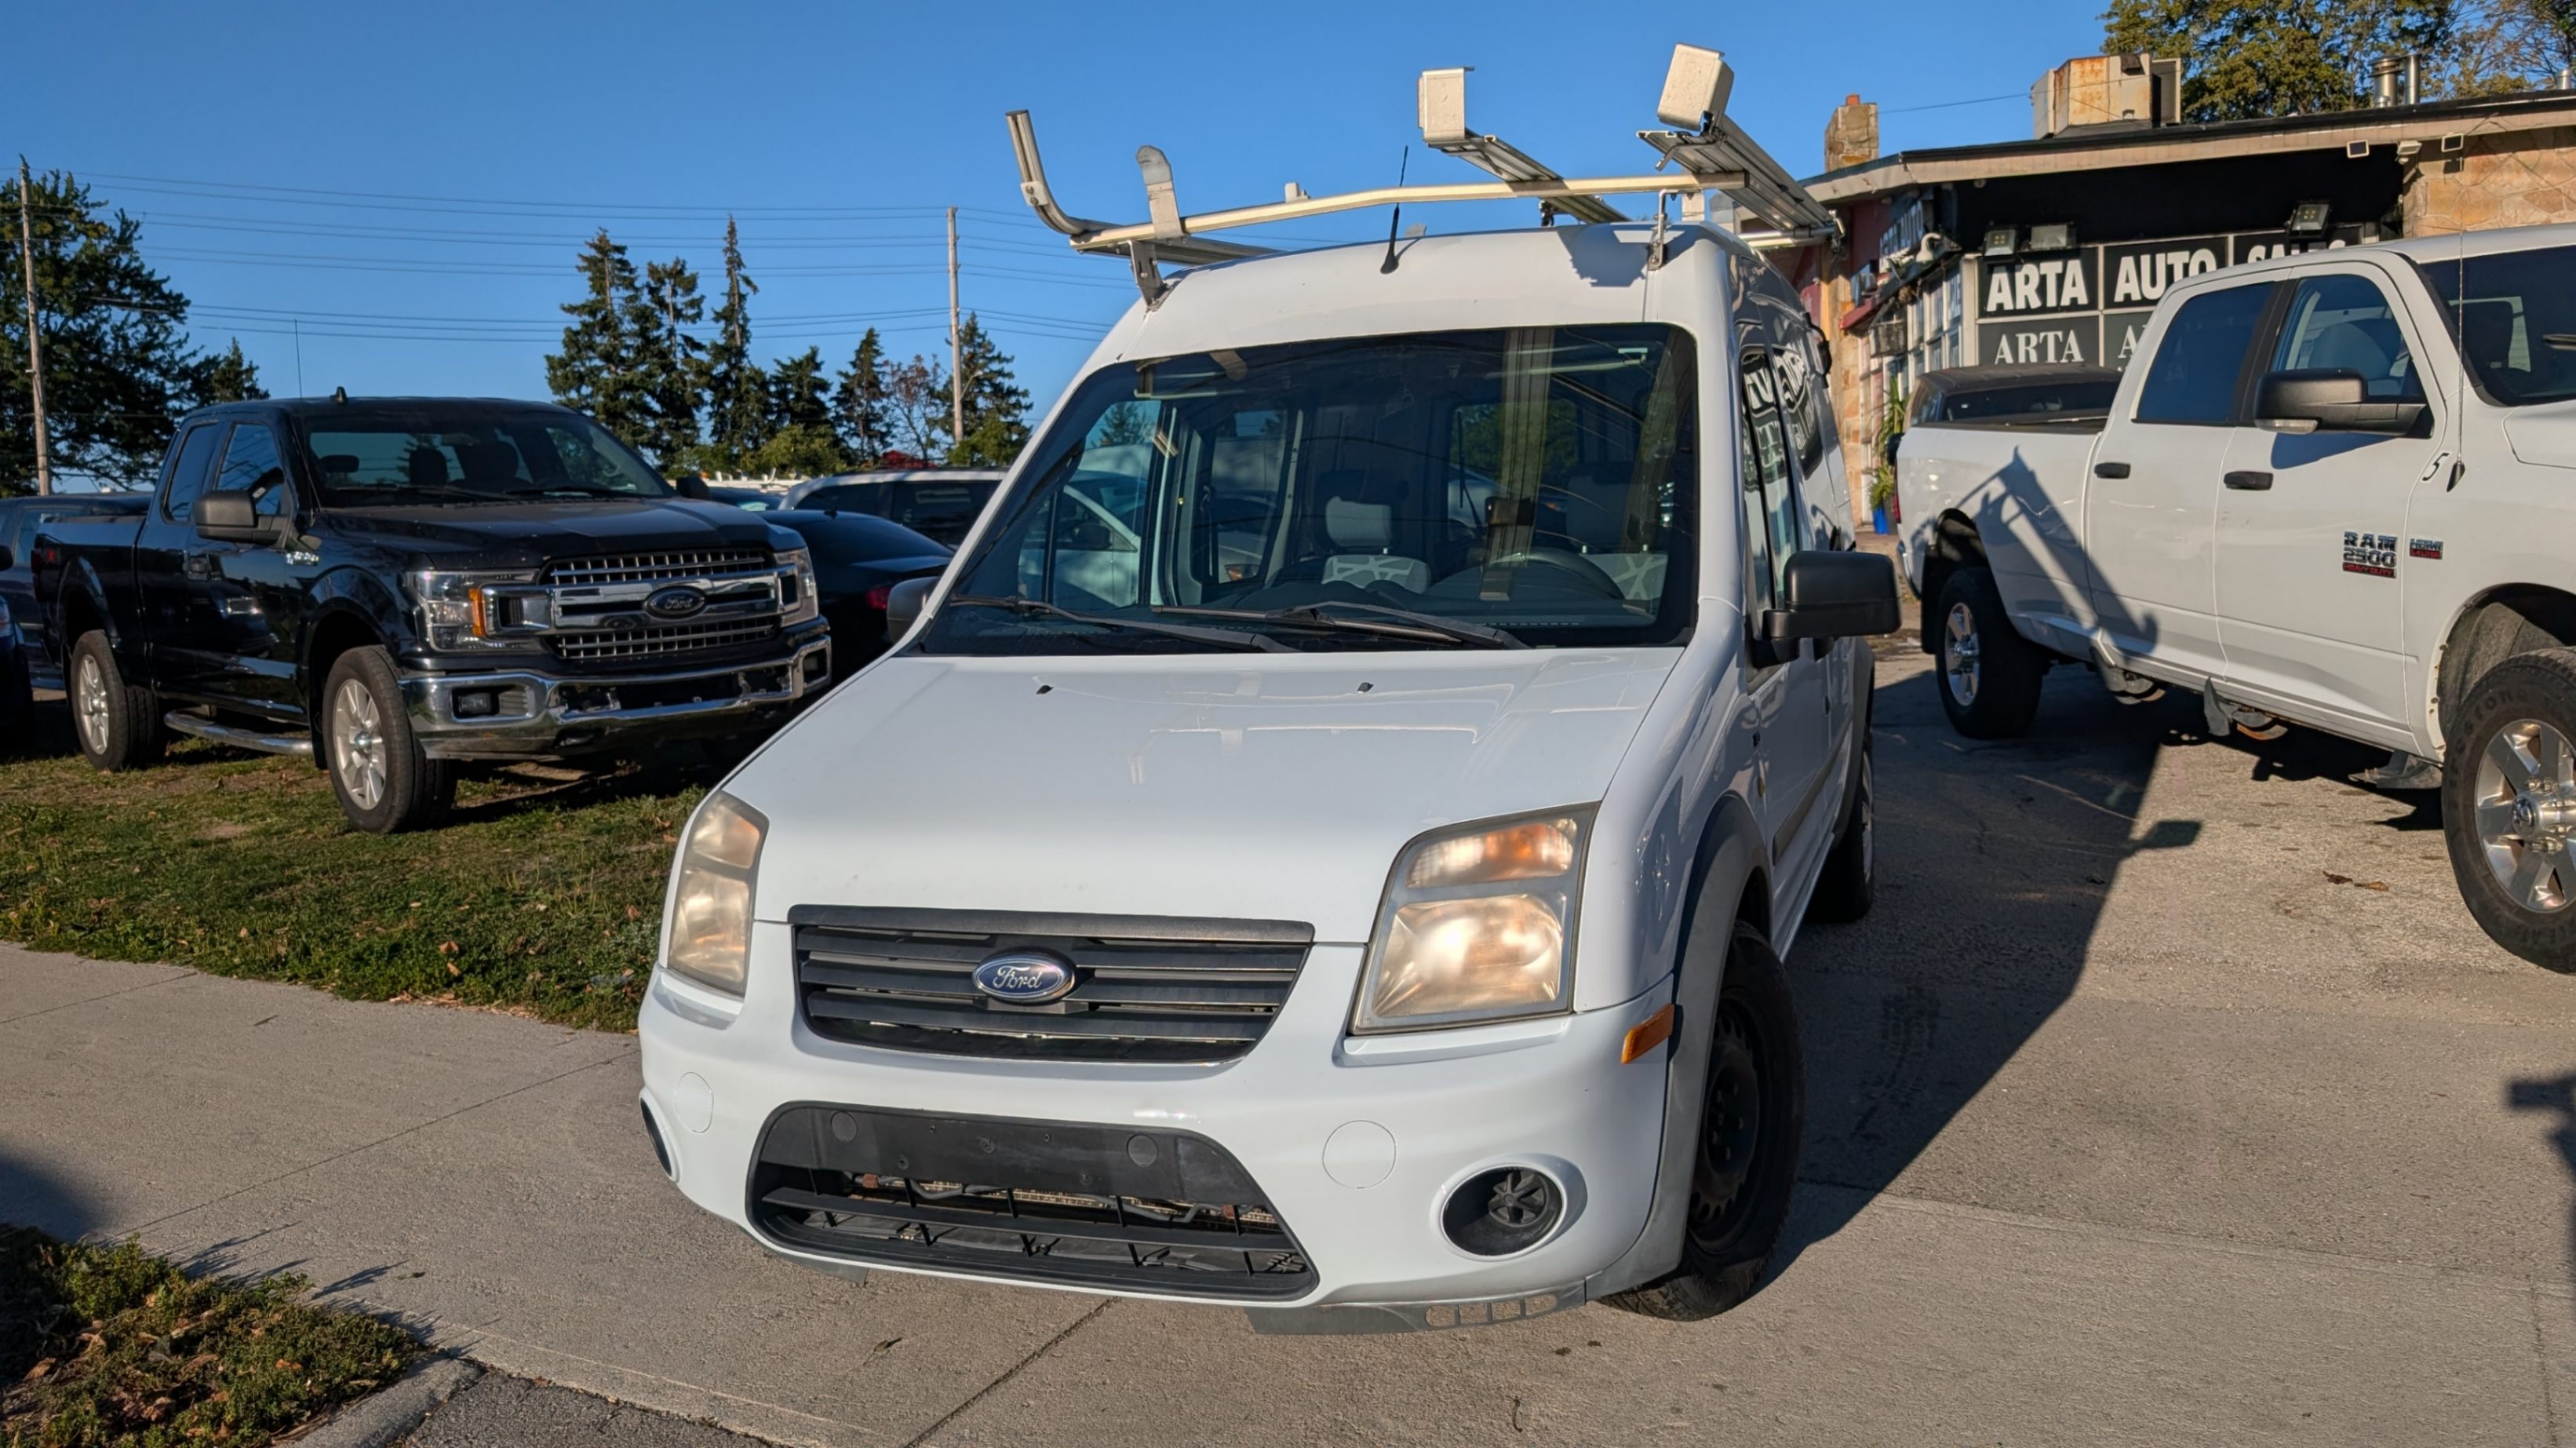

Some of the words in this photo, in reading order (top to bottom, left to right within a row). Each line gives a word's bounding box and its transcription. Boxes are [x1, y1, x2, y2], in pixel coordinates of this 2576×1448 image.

[1987, 260, 2088, 312] ARTA
[1995, 330, 2084, 365] ARTA
[2344, 531, 2398, 552] RAM
[2343, 547, 2396, 567] 2500
[2344, 564, 2368, 574] HEAVY
[2370, 567, 2392, 577] DUTY
[665, 597, 694, 609] Ford
[993, 965, 1043, 989] Ford
